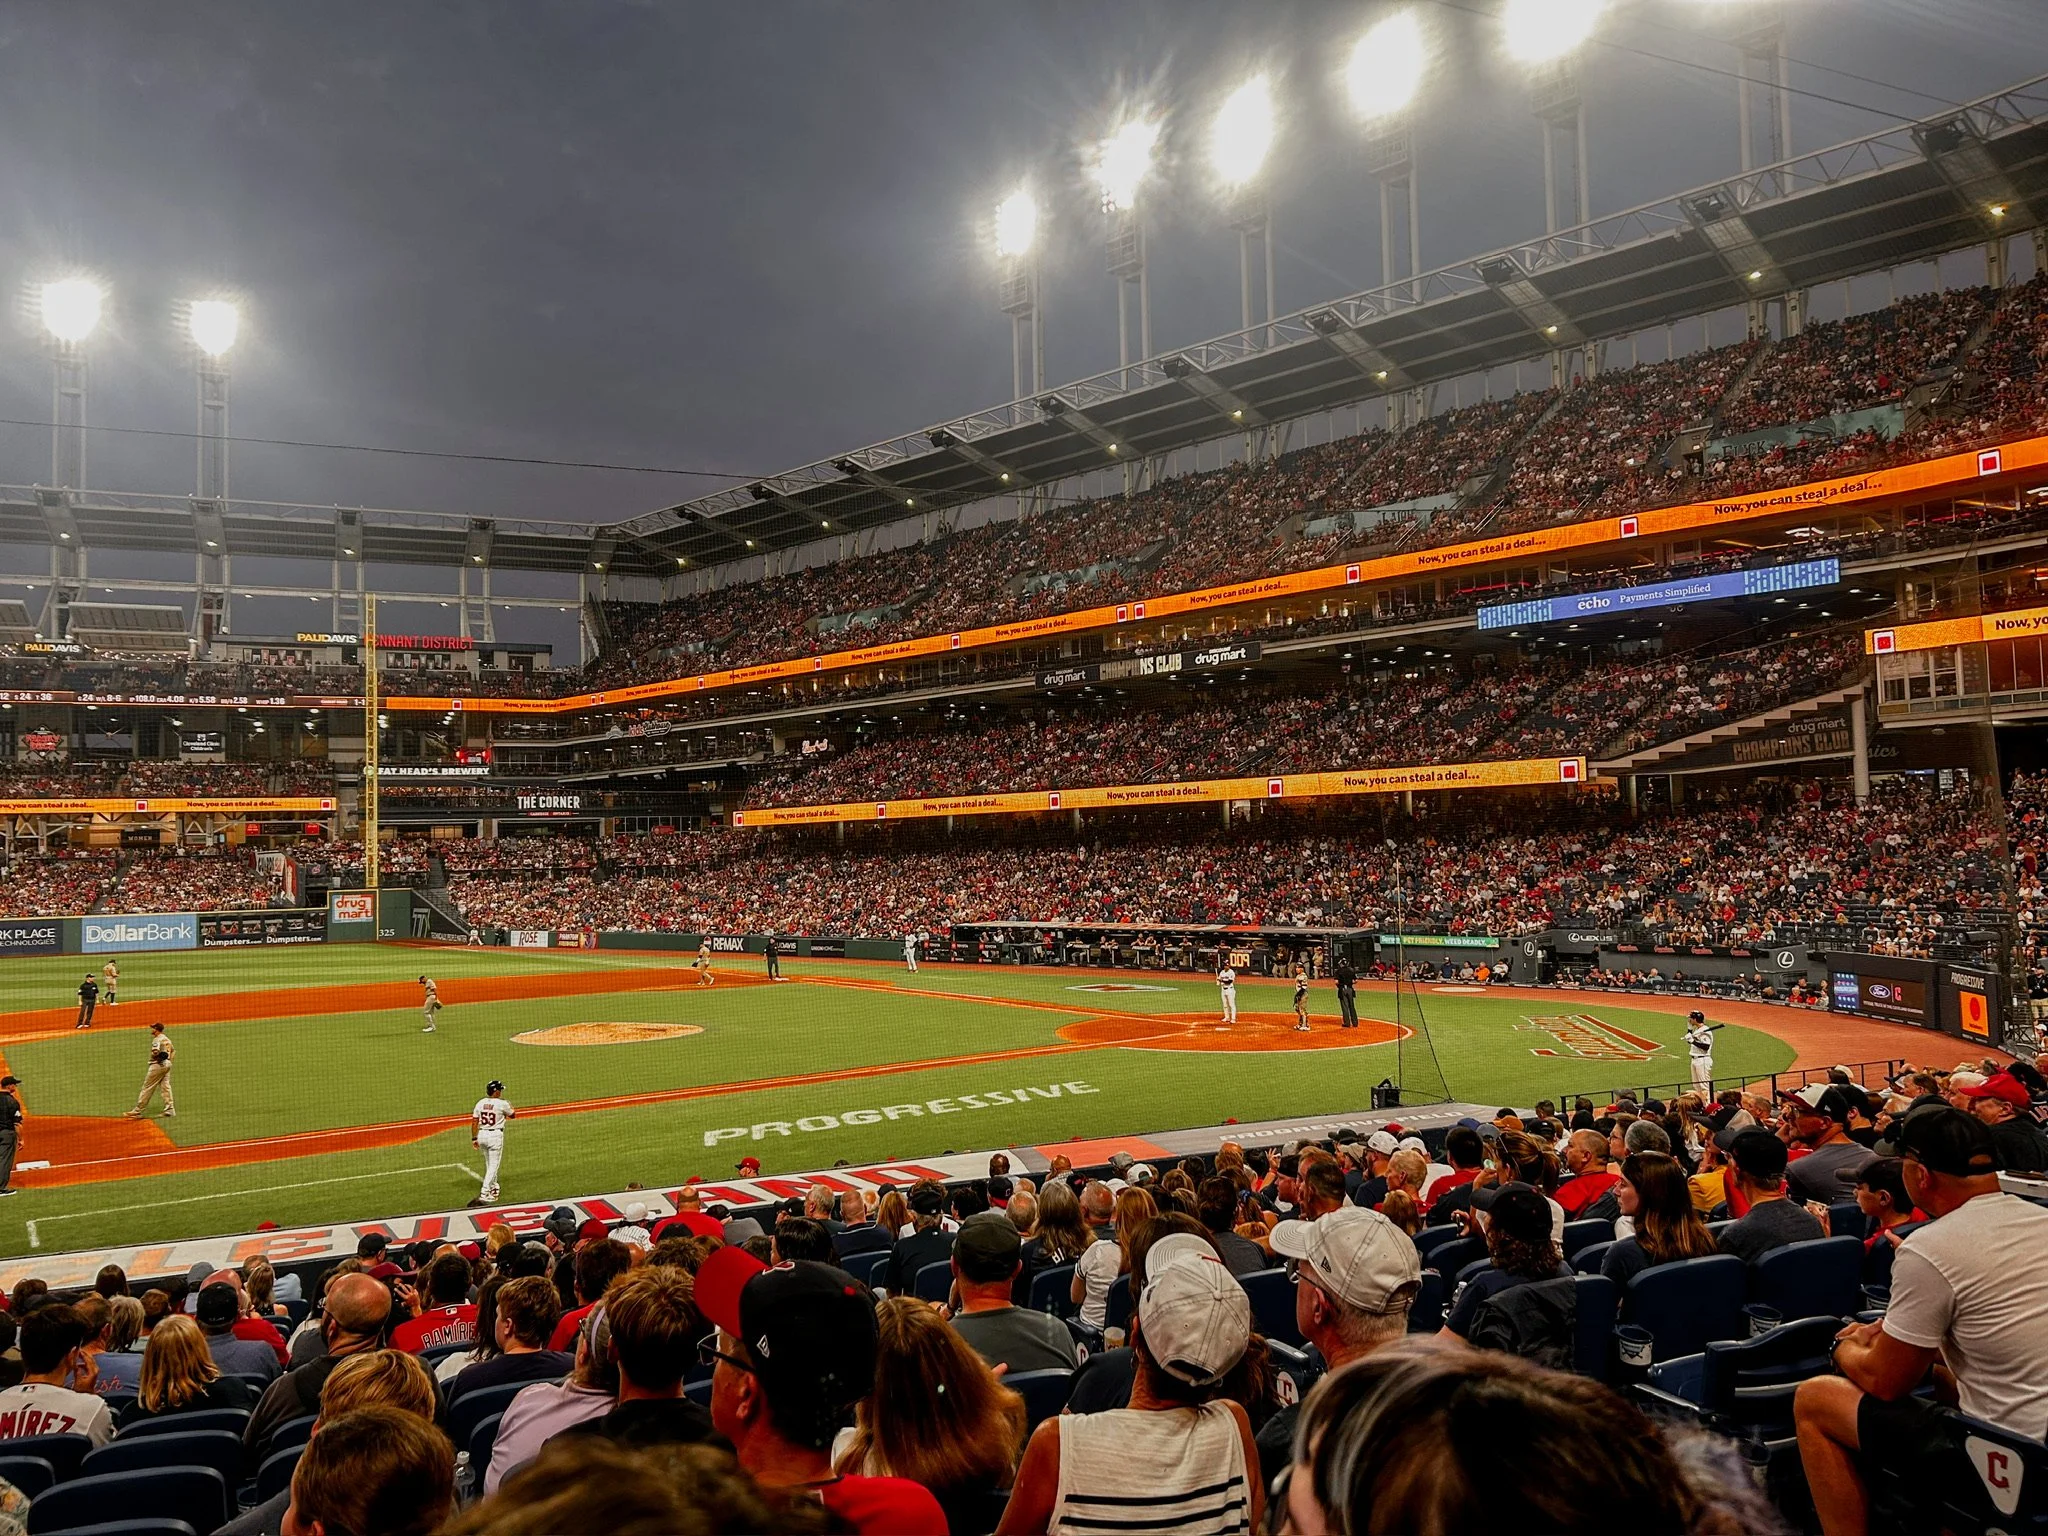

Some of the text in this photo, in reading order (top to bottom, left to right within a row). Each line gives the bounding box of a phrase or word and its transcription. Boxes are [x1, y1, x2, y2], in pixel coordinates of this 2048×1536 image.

[1745, 500, 1767, 511] you
[1770, 496, 1792, 505] can
[1795, 487, 1827, 502] steal
[1830, 488, 1837, 496] a
[1442, 552, 1459, 563] you
[1461, 549, 1478, 558] can
[1480, 542, 1504, 554] steal
[1208, 593, 1223, 602] you
[1238, 585, 1257, 596] steal
[1577, 583, 1711, 610] echo Payments Simplified
[1011, 627, 1020, 636] you
[1034, 622, 1048, 630] steal
[1996, 616, 2048, 630] Now, yo
[422, 635, 472, 649] DISTRICT
[1156, 653, 1182, 673] CLUB
[1195, 647, 1246, 665] drug mart
[1044, 670, 1086, 685] drug mart
[20, 693, 32, 701] 24
[1788, 718, 1846, 735] drug mart
[1734, 730, 1850, 762] CHAMPIONS CLUB
[379, 767, 490, 776] FAT HEAD'S BREWERY
[1369, 777, 1387, 787] you
[1389, 775, 1408, 784] can
[1409, 771, 1434, 783] steal
[1126, 791, 1140, 800] you
[1155, 787, 1175, 796] steal
[517, 795, 581, 809] THE CORNER
[938, 803, 949, 812] you
[962, 800, 977, 808] steal
[335, 896, 366, 911] drug
[338, 909, 372, 919] mart
[15, 928, 56, 939] PLACE
[379, 928, 395, 937] 325
[519, 932, 538, 946] ROSE
[0, 937, 55, 947] ECHNOLOGIES
[1951, 971, 1986, 990] PROGRESSIVE
[480, 1111, 496, 1126] 53
[703, 1079, 1101, 1147] PROGRESSIVE
[1218, 1110, 1465, 1142] PROGRESSIVE FIELD
[1, 1164, 951, 1289] CLEVELAND
[421, 1318, 477, 1349] RAMÍRE
[0, 1402, 77, 1440] MÍREZ
[1987, 1451, 2010, 1488] C
